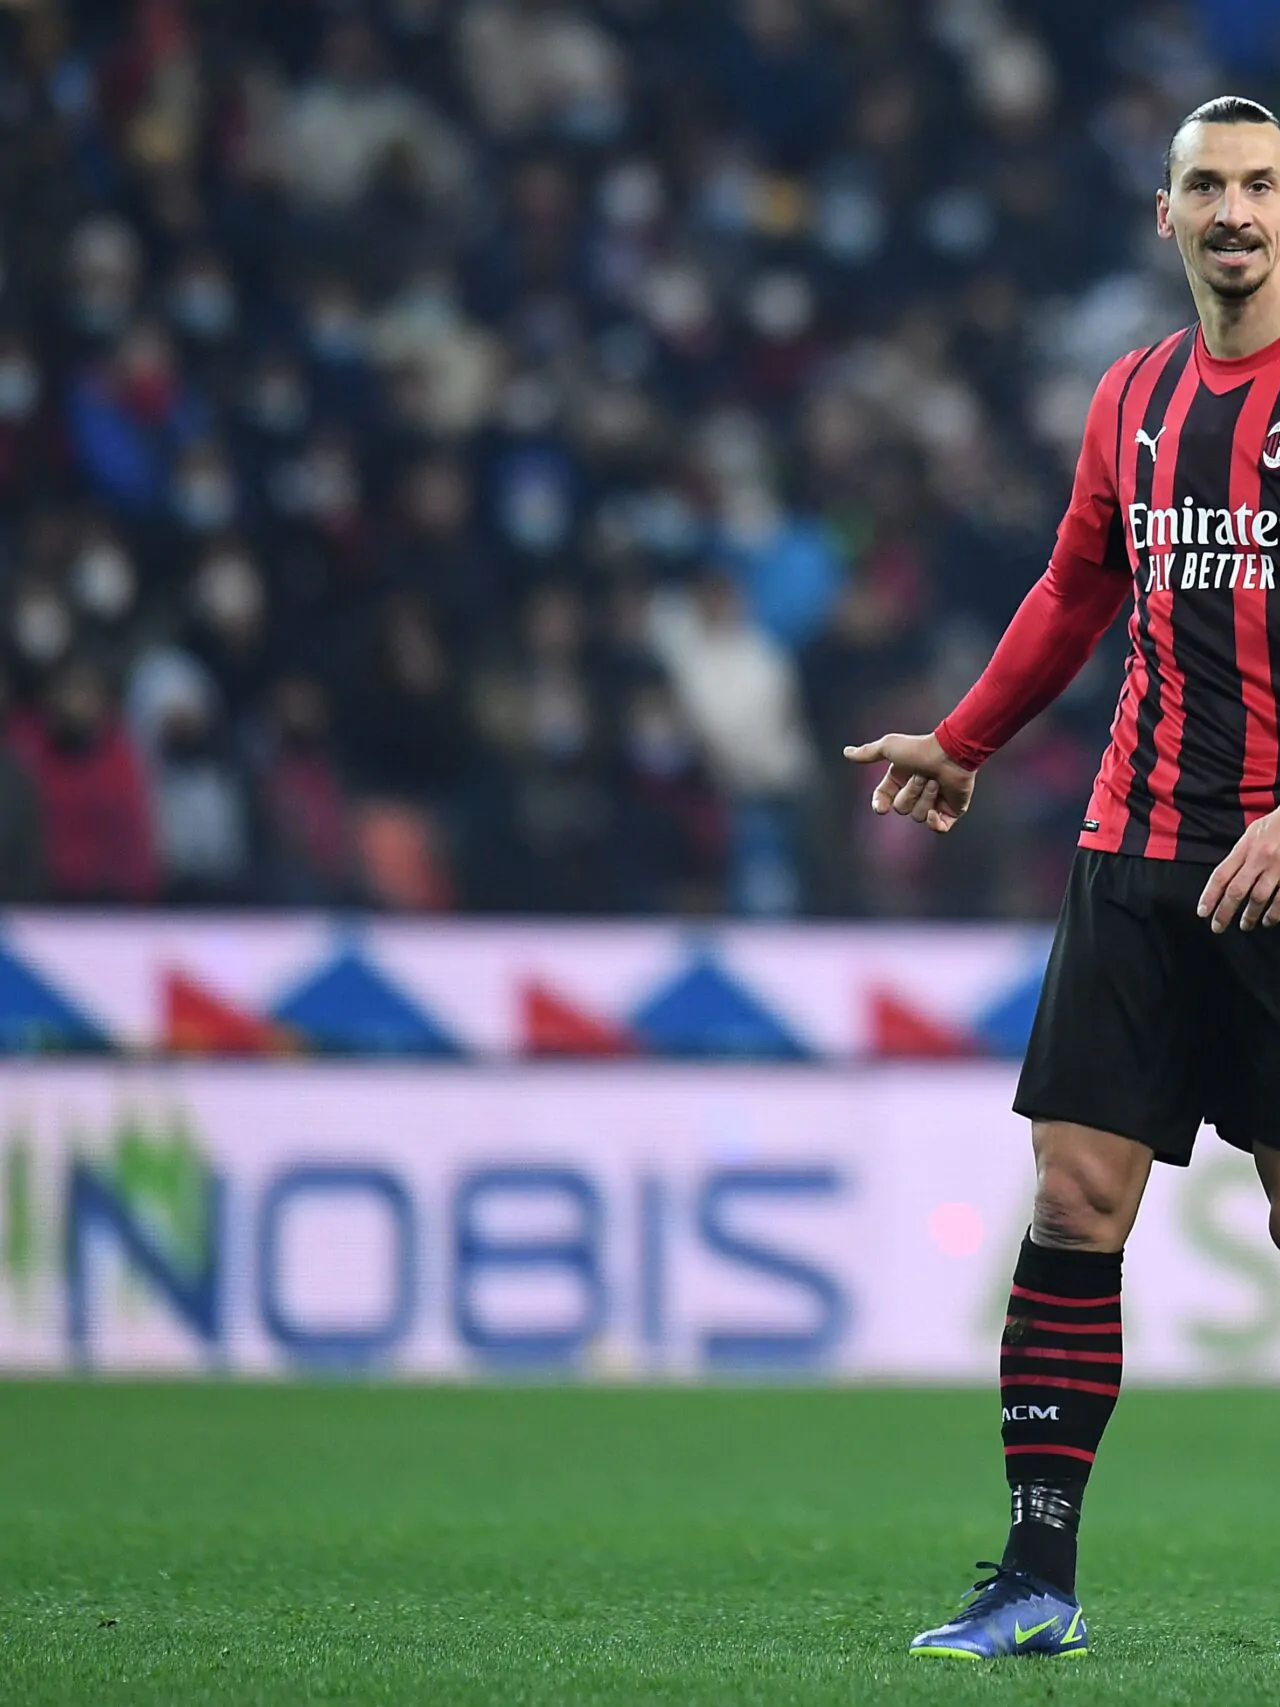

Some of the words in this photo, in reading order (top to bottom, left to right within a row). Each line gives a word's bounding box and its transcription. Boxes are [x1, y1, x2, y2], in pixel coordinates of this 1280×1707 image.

[1145, 553, 1176, 592] FLY
[1180, 552, 1275, 590] BETTER
[62, 1155, 856, 1375] NOBIS
[1002, 1405, 1060, 1422] ACM
